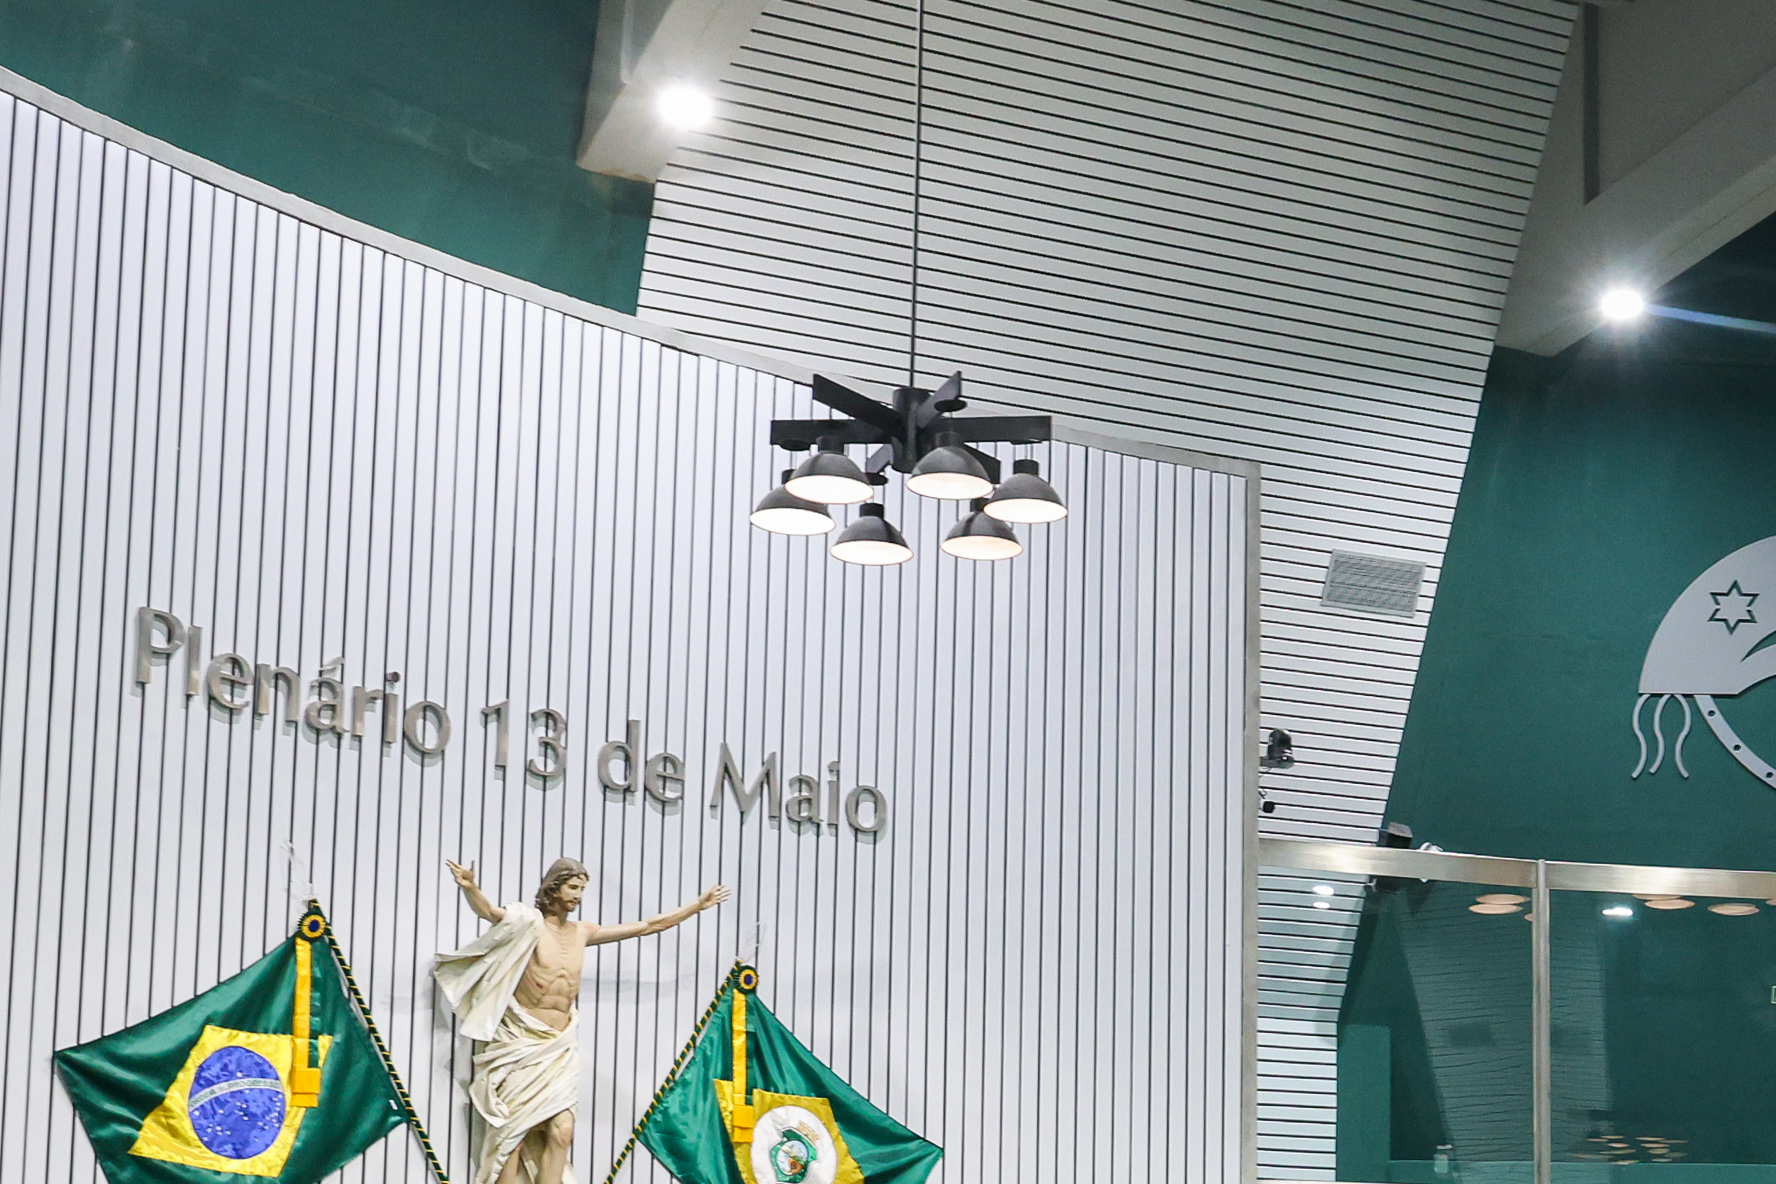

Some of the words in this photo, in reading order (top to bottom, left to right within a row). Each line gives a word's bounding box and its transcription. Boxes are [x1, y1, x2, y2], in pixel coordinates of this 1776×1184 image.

[137, 606, 452, 757] Plenário
[481, 699, 568, 778] 13
[599, 719, 685, 803] de
[710, 741, 888, 834] Maio
